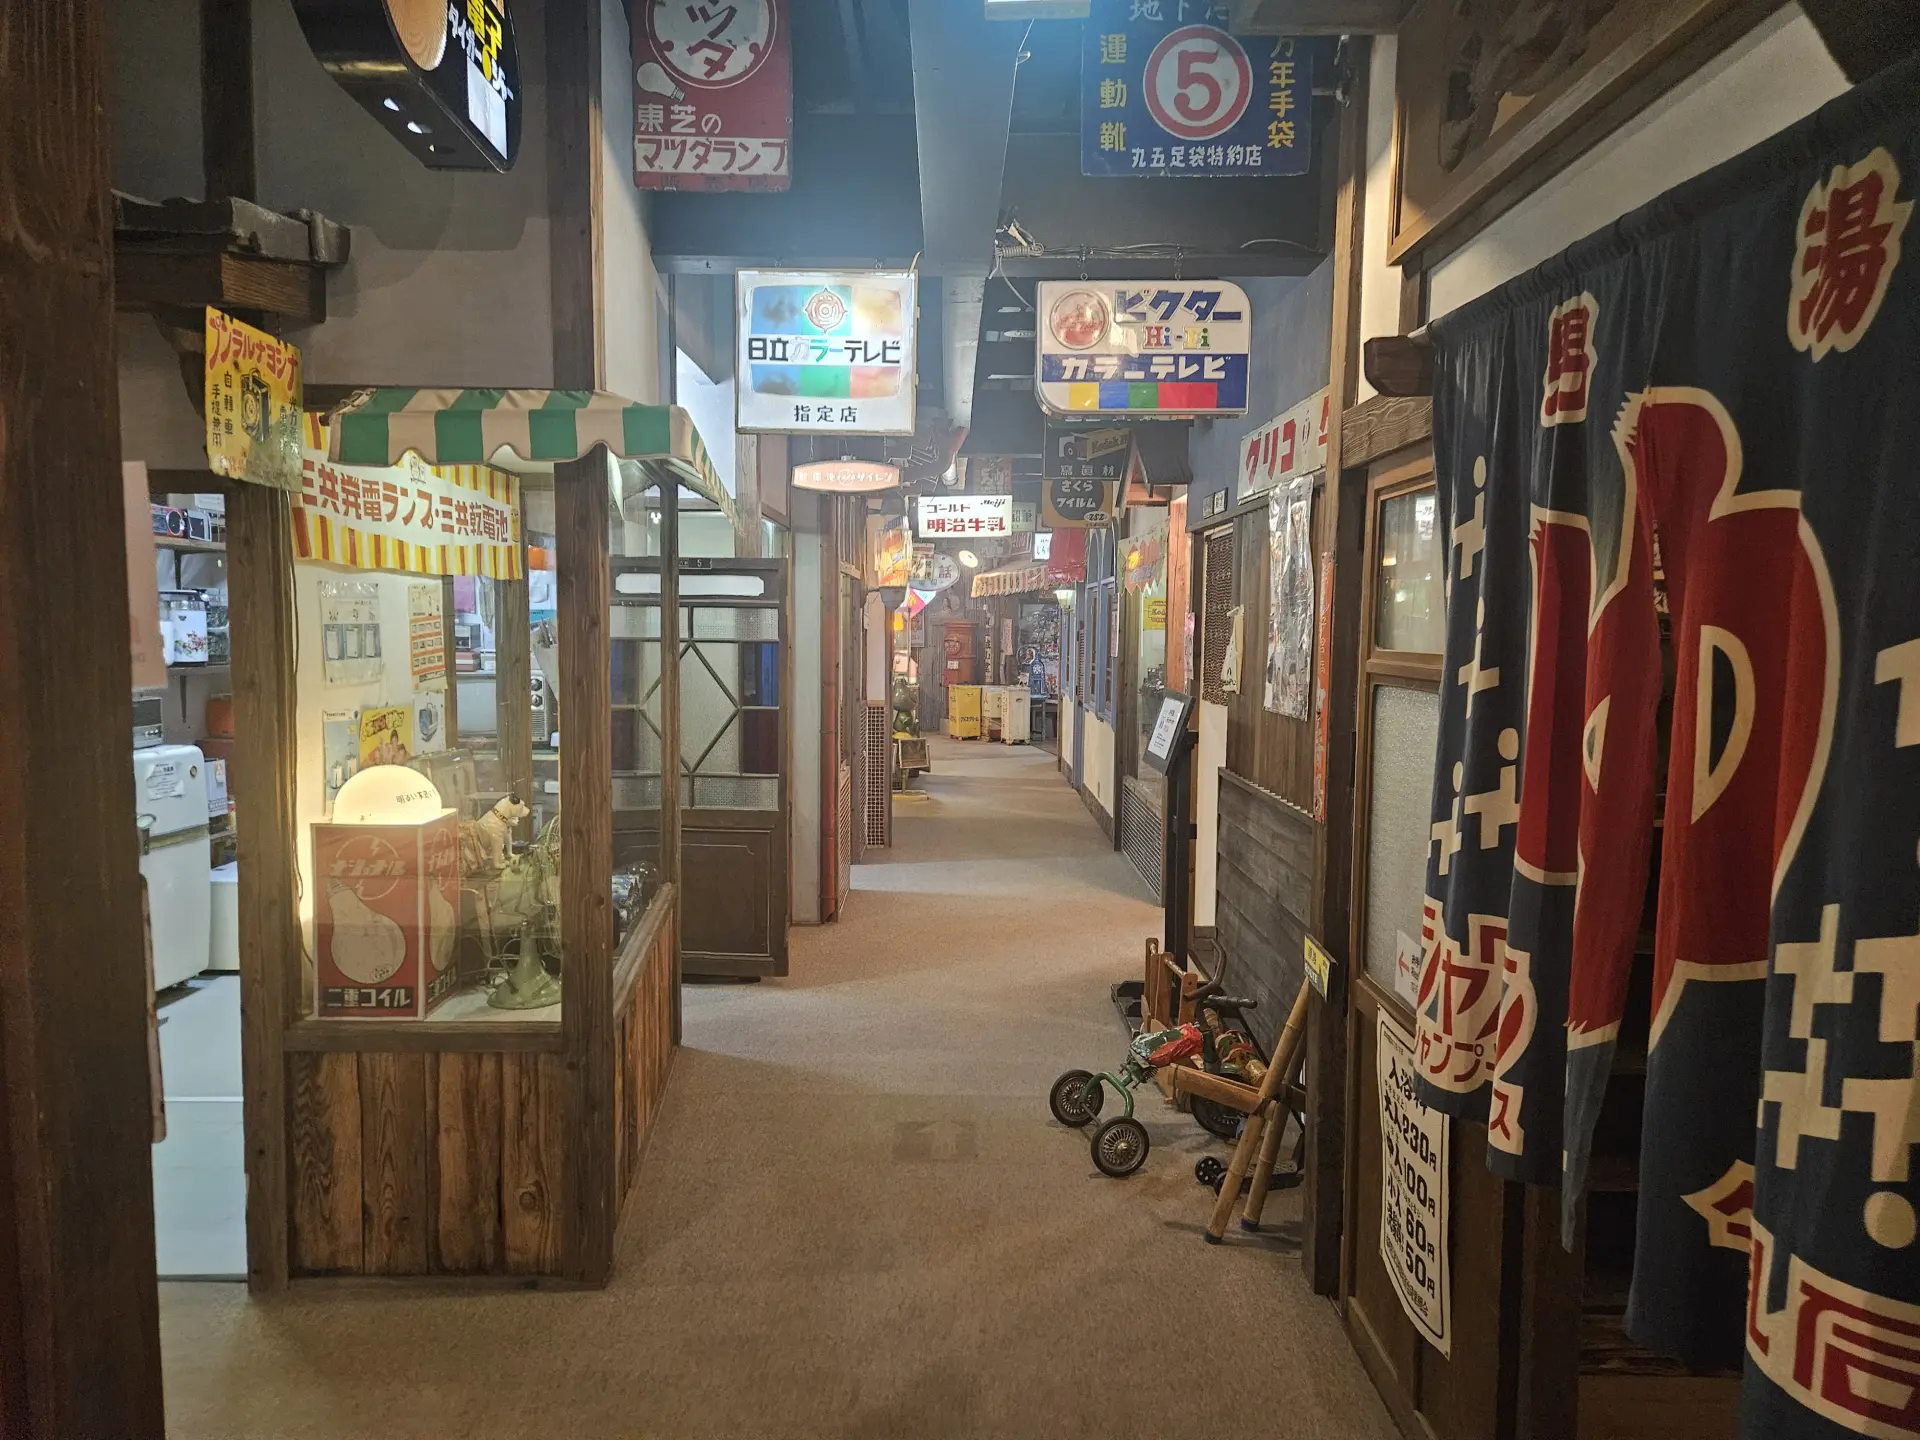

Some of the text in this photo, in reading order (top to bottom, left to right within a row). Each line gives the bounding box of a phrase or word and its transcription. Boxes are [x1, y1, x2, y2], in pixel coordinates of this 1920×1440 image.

[683, 0, 738, 79] ツダ
[1100, 33, 1128, 153] 運動靴
[638, 103, 722, 135] 東芝の
[637, 138, 789, 173] マツダランプ
[1795, 158, 1902, 352] 湯
[1115, 289, 1242, 322] ビクター
[748, 337, 901, 364] 日立カラーテレビ
[1144, 325, 1210, 348] Hi-Fi
[1062, 354, 1232, 380] カラーテレビ
[793, 404, 858, 423] 指定店
[1246, 417, 1296, 485] グリコ
[926, 516, 1006, 533] 明治牛乳
[327, 988, 411, 1008] 二重コイル
[1405, 1206, 1436, 1263] 60円
[1405, 1239, 1436, 1300] 50円
